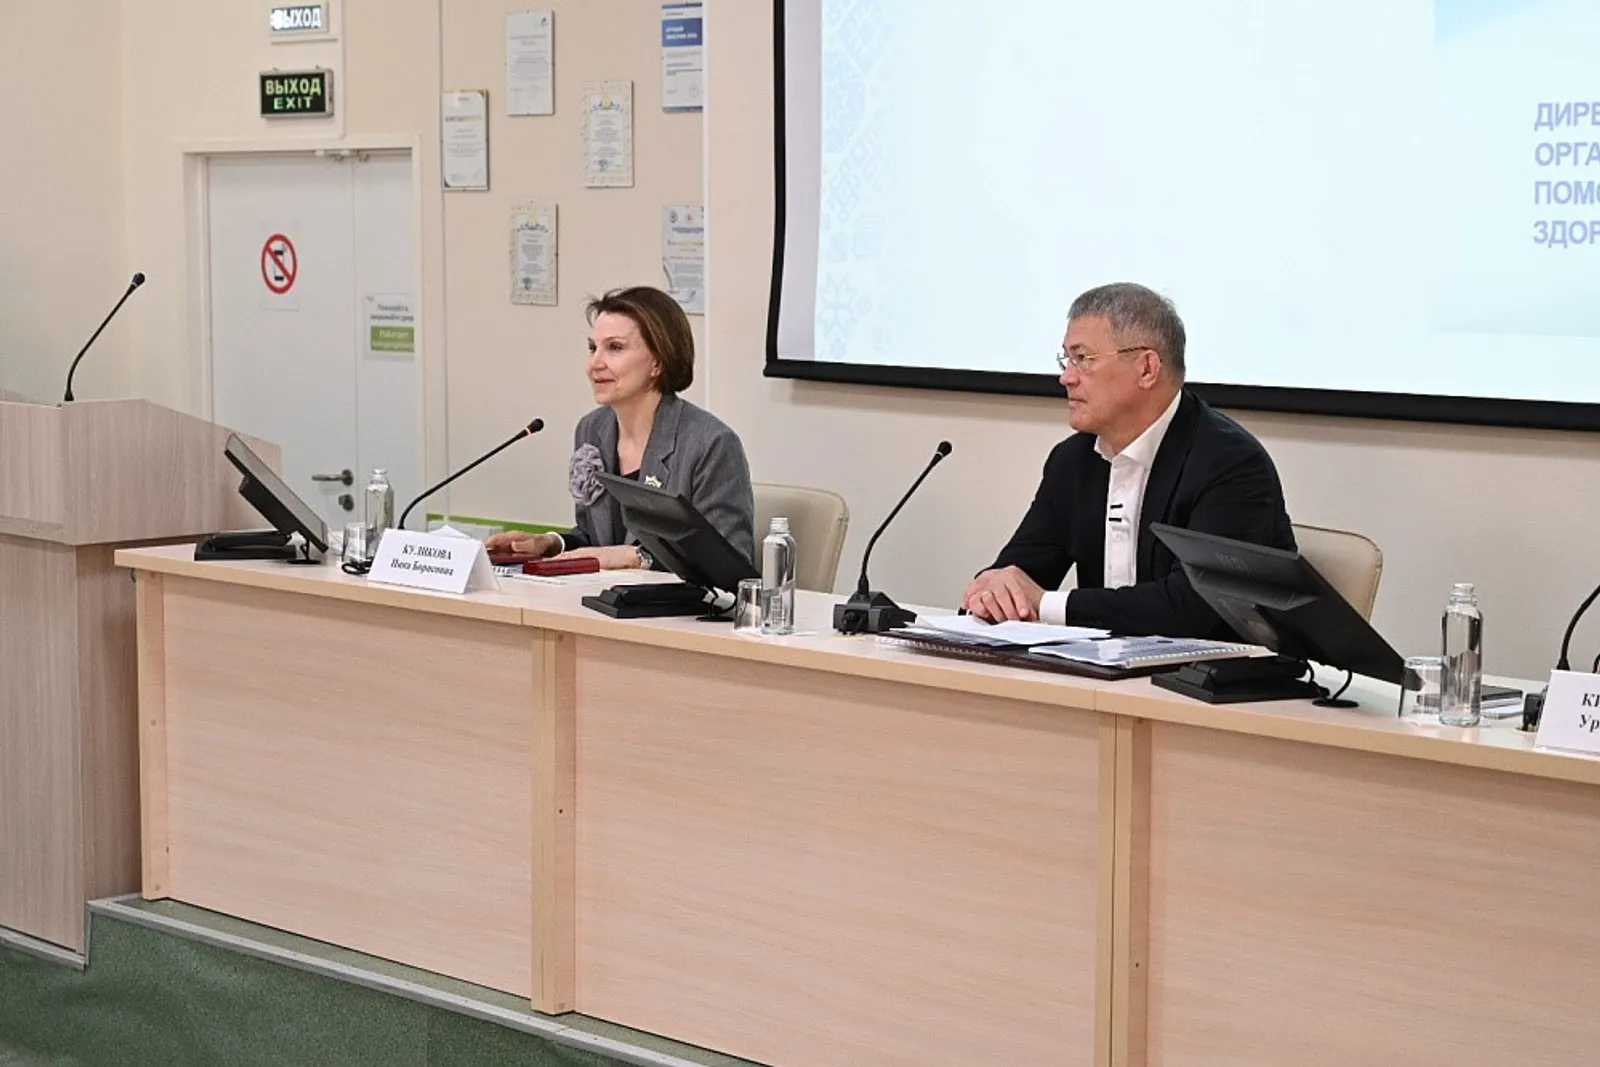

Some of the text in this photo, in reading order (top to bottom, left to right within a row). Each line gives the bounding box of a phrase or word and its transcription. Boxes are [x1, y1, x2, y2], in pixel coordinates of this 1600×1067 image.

[265, 78, 322, 96] ВЫХОД
[273, 97, 313, 110] EXIT
[1534, 142, 1600, 166] ОРГА
[1534, 180, 1600, 205] ПОМ
